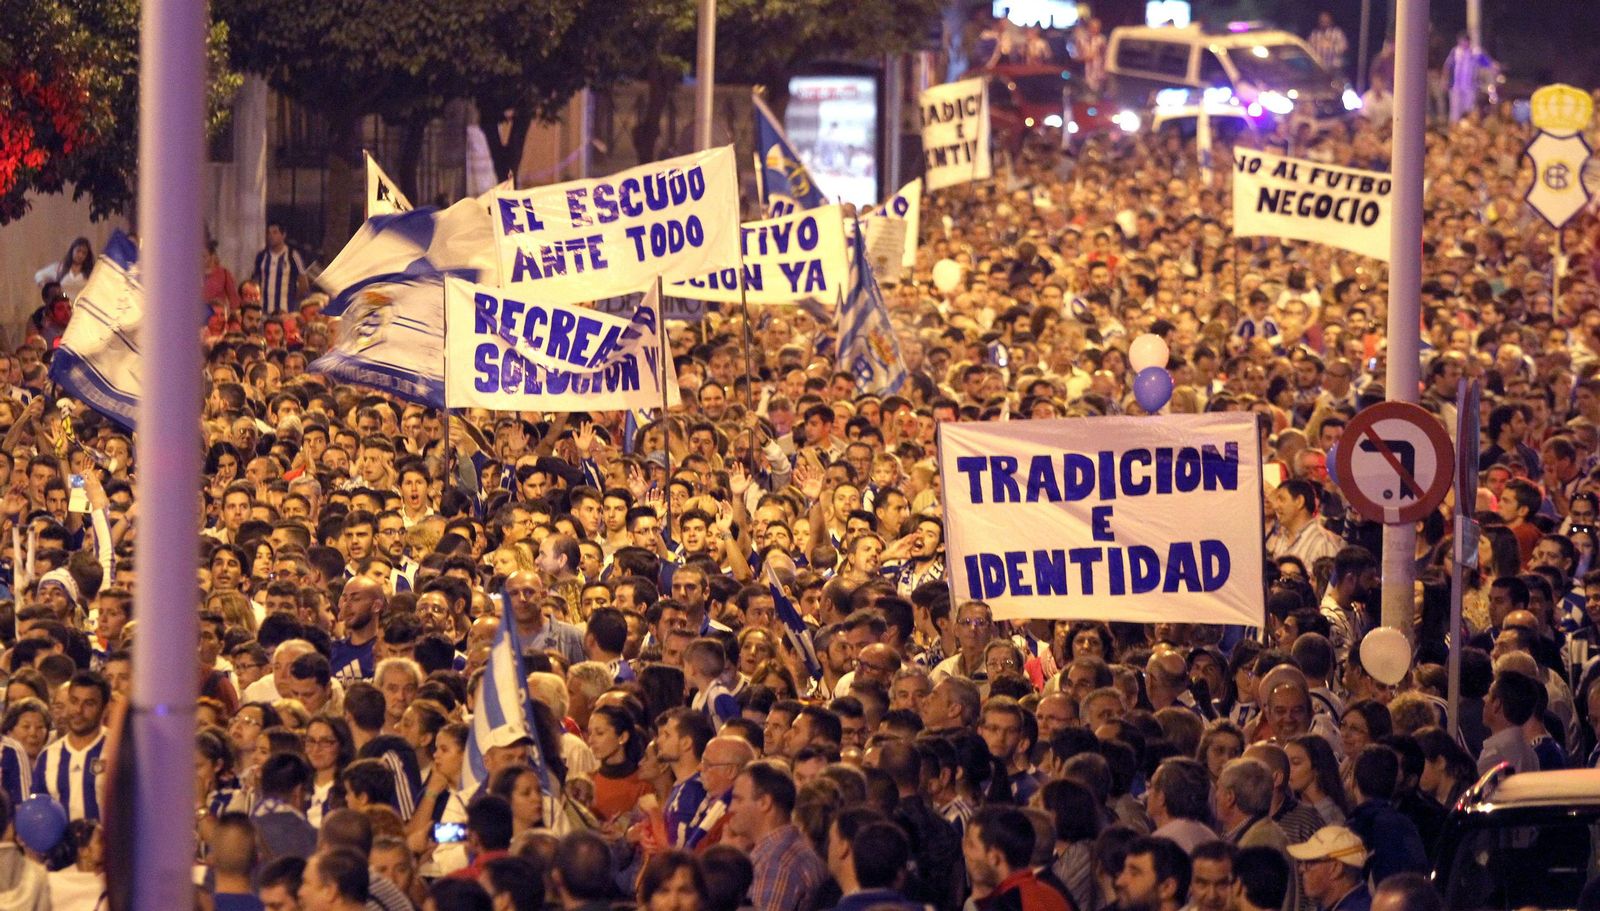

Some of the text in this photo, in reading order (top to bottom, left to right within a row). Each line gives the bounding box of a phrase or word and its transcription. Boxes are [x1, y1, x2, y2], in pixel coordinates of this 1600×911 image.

[956, 123, 964, 138] E
[1272, 161, 1298, 181] AL
[497, 165, 705, 235] EL ESCUDO
[1256, 187, 1380, 227] NEGOCIO
[511, 214, 704, 282] ANTE TODO
[778, 259, 827, 293] YA
[957, 441, 1239, 504] TRADICION
[1091, 505, 1115, 542] E
[964, 539, 1231, 600] IDENTIDAD
